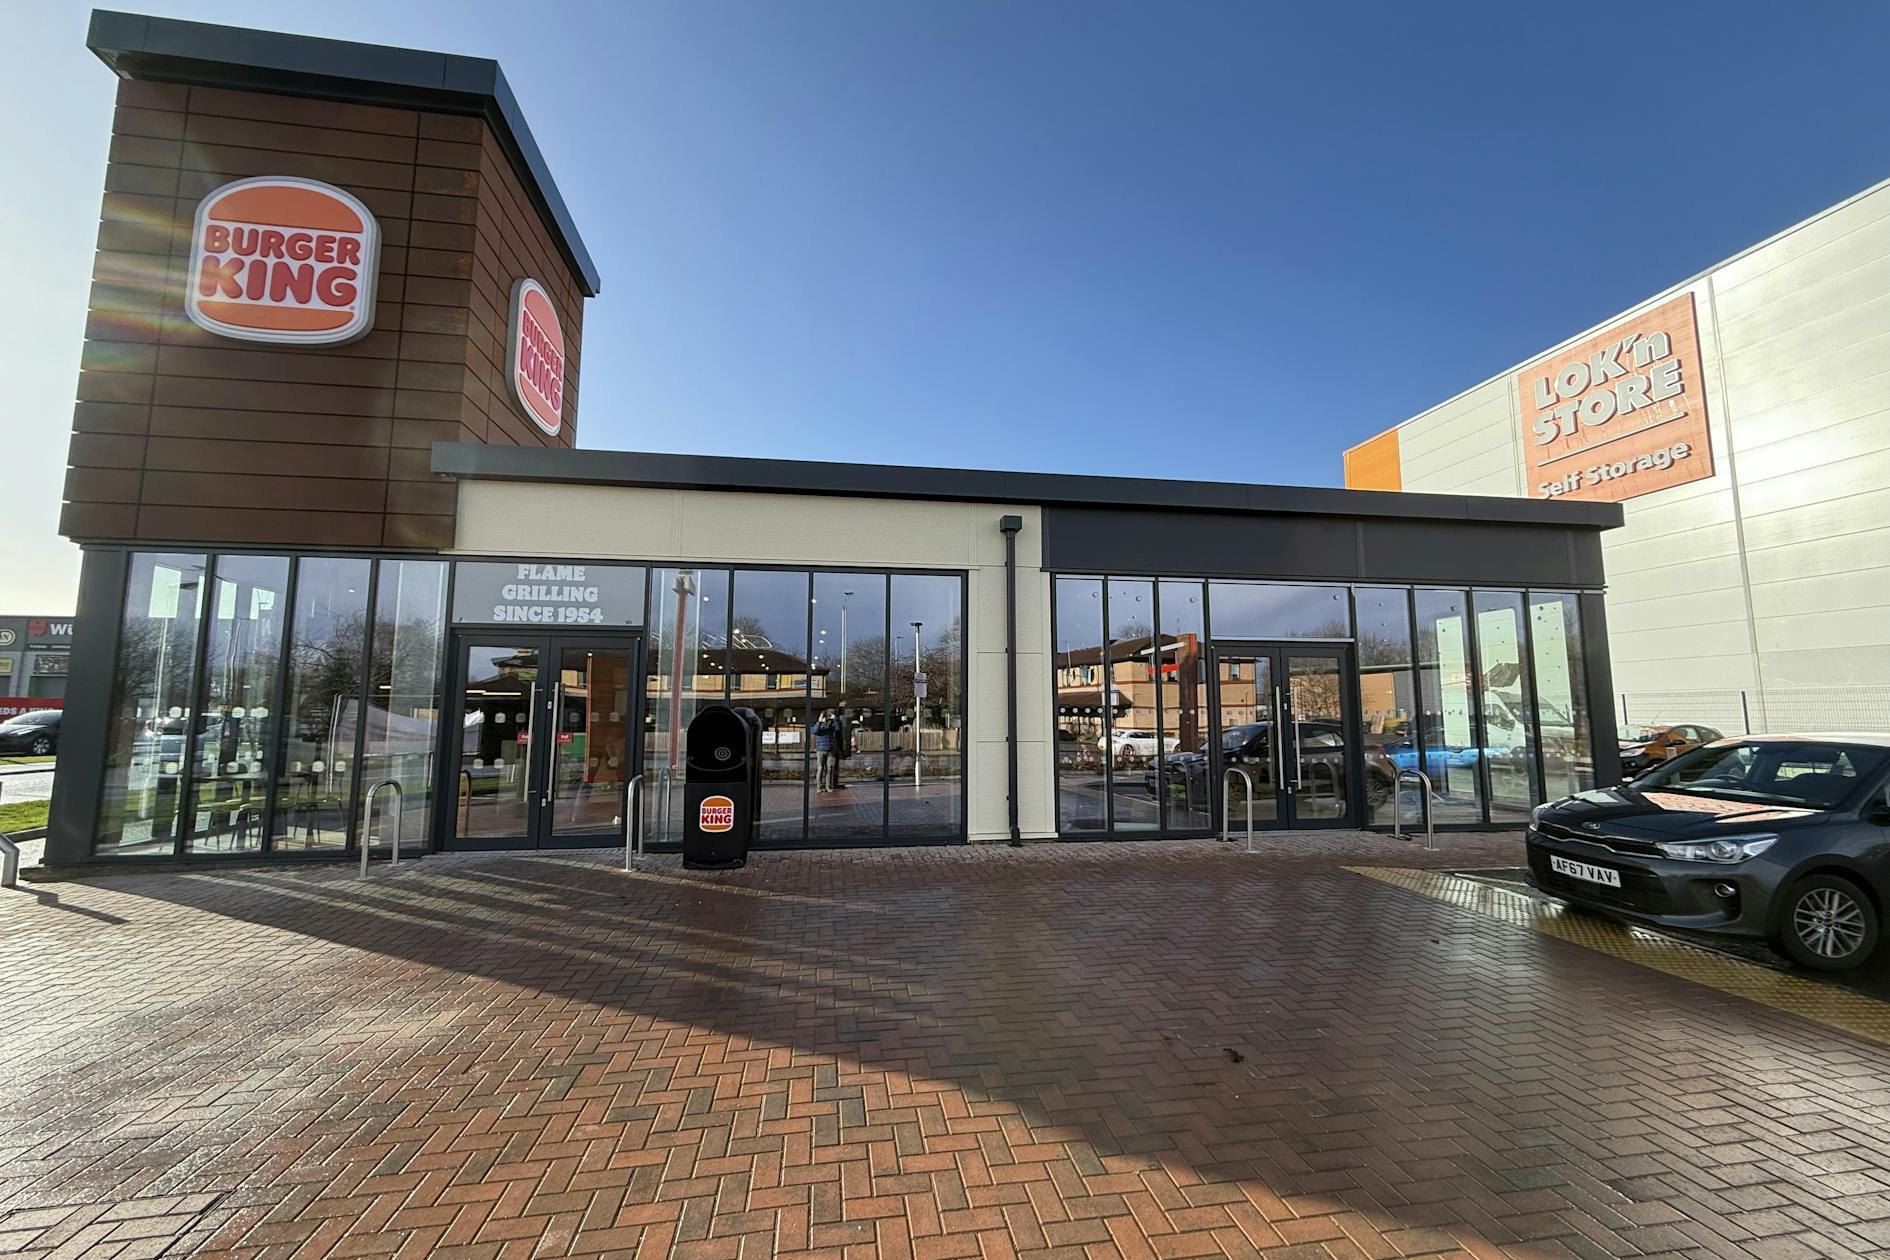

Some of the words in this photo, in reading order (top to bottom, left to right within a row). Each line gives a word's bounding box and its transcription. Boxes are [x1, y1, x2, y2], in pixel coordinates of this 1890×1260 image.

[204, 224, 361, 266] BURGER
[199, 255, 358, 307] KING
[522, 310, 563, 382] BURGER
[520, 336, 561, 411] KING
[1532, 357, 1686, 446] STORE
[1537, 471, 1584, 499] Self
[1585, 442, 1692, 486] Storage
[517, 564, 586, 581] FLAME
[502, 584, 599, 603] GRILLING
[493, 605, 555, 622] SINCE
[557, 607, 604, 624] 1954
[701, 807, 732, 815] BURGER
[701, 814, 732, 824] KING
[1556, 858, 1583, 876] AF67
[1587, 866, 1613, 883] VAV
